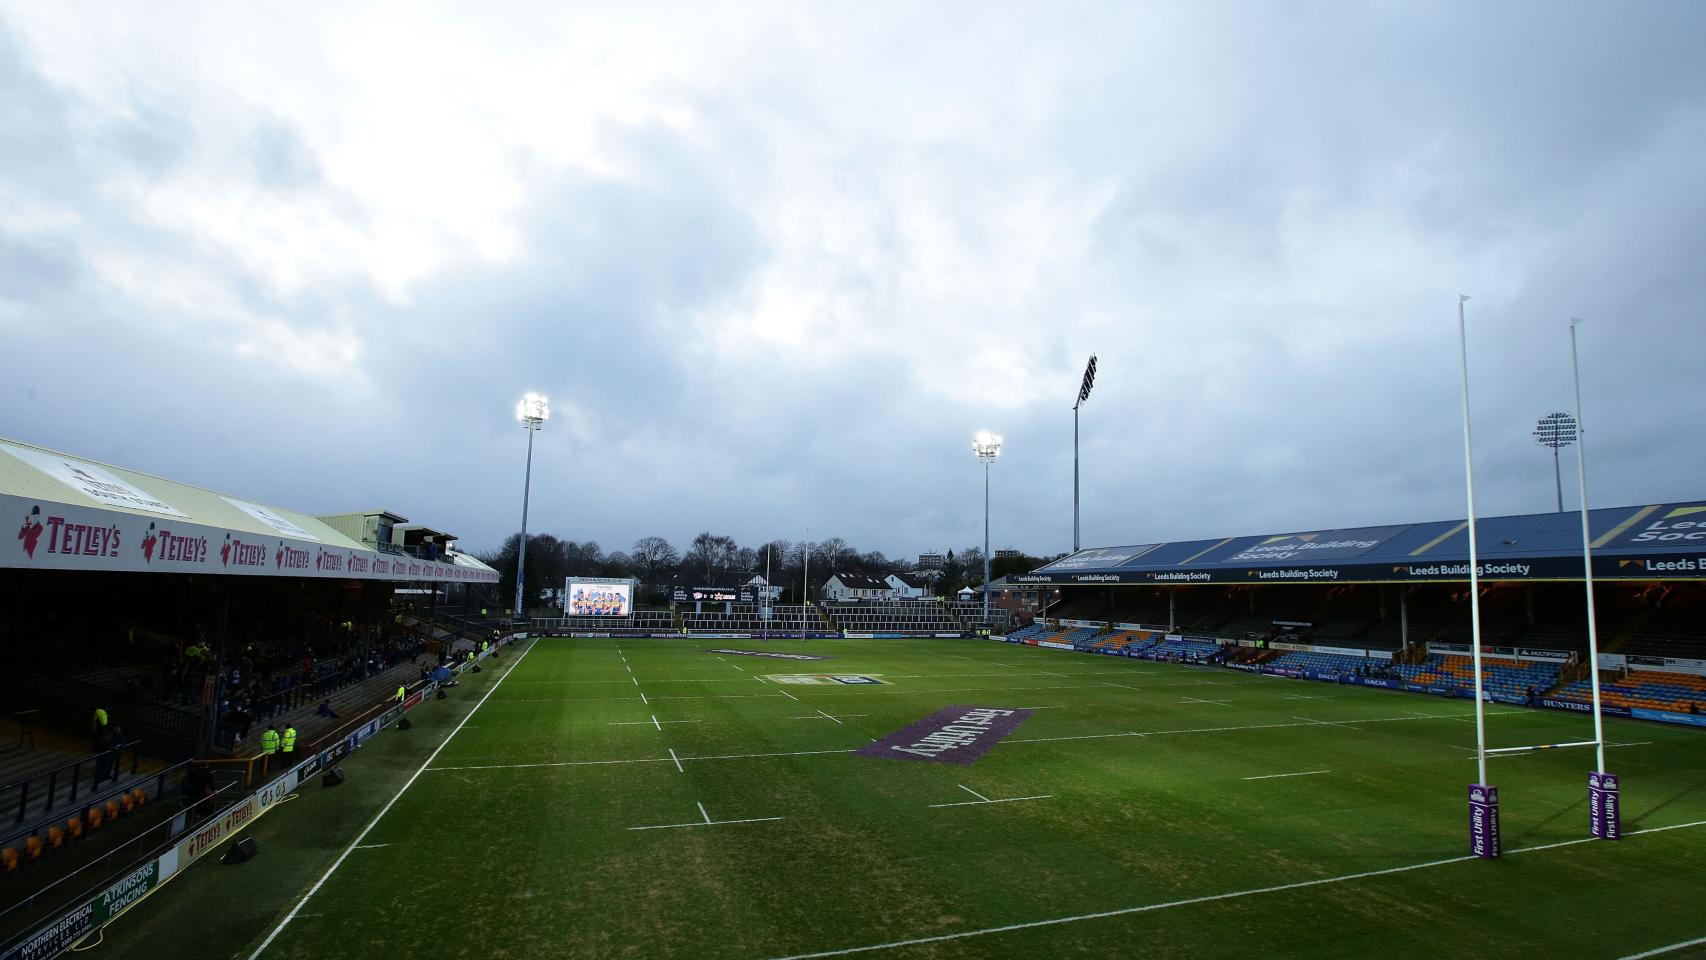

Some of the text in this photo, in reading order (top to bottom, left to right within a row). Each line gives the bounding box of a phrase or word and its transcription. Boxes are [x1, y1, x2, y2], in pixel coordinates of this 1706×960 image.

[47, 516, 120, 557] TETLEY'S
[159, 531, 207, 562] TETLEY'S
[1246, 540, 1379, 553] Leeds Building
[232, 540, 266, 566] TETLEY'S
[284, 546, 310, 569] TETLEY'S
[322, 551, 342, 571] TETLEY'S
[1232, 551, 1299, 560] Society
[1646, 558, 1697, 571] Leeds
[1105, 574, 1120, 582] Society
[1170, 572, 1190, 581] Building
[1190, 572, 1211, 580] Society
[1259, 569, 1338, 580] Leeds Building Society
[1409, 563, 1530, 576] Leeds Buildig Society
[1543, 699, 1591, 711] HUNTERS
[891, 708, 1015, 758] First Utility
[231, 802, 252, 827] TETLEY'S
[1591, 791, 1599, 817] Utility
[1605, 793, 1616, 838] First Utility
[196, 823, 221, 851] TETLEY'S
[1472, 806, 1484, 855] First Utility
[103, 864, 154, 906] ATKINSONS
[109, 881, 148, 916] FENCING
[21, 925, 59, 958] NORTHERN
[60, 904, 93, 932] ELECTRICAL
[76, 916, 89, 931] LTD
